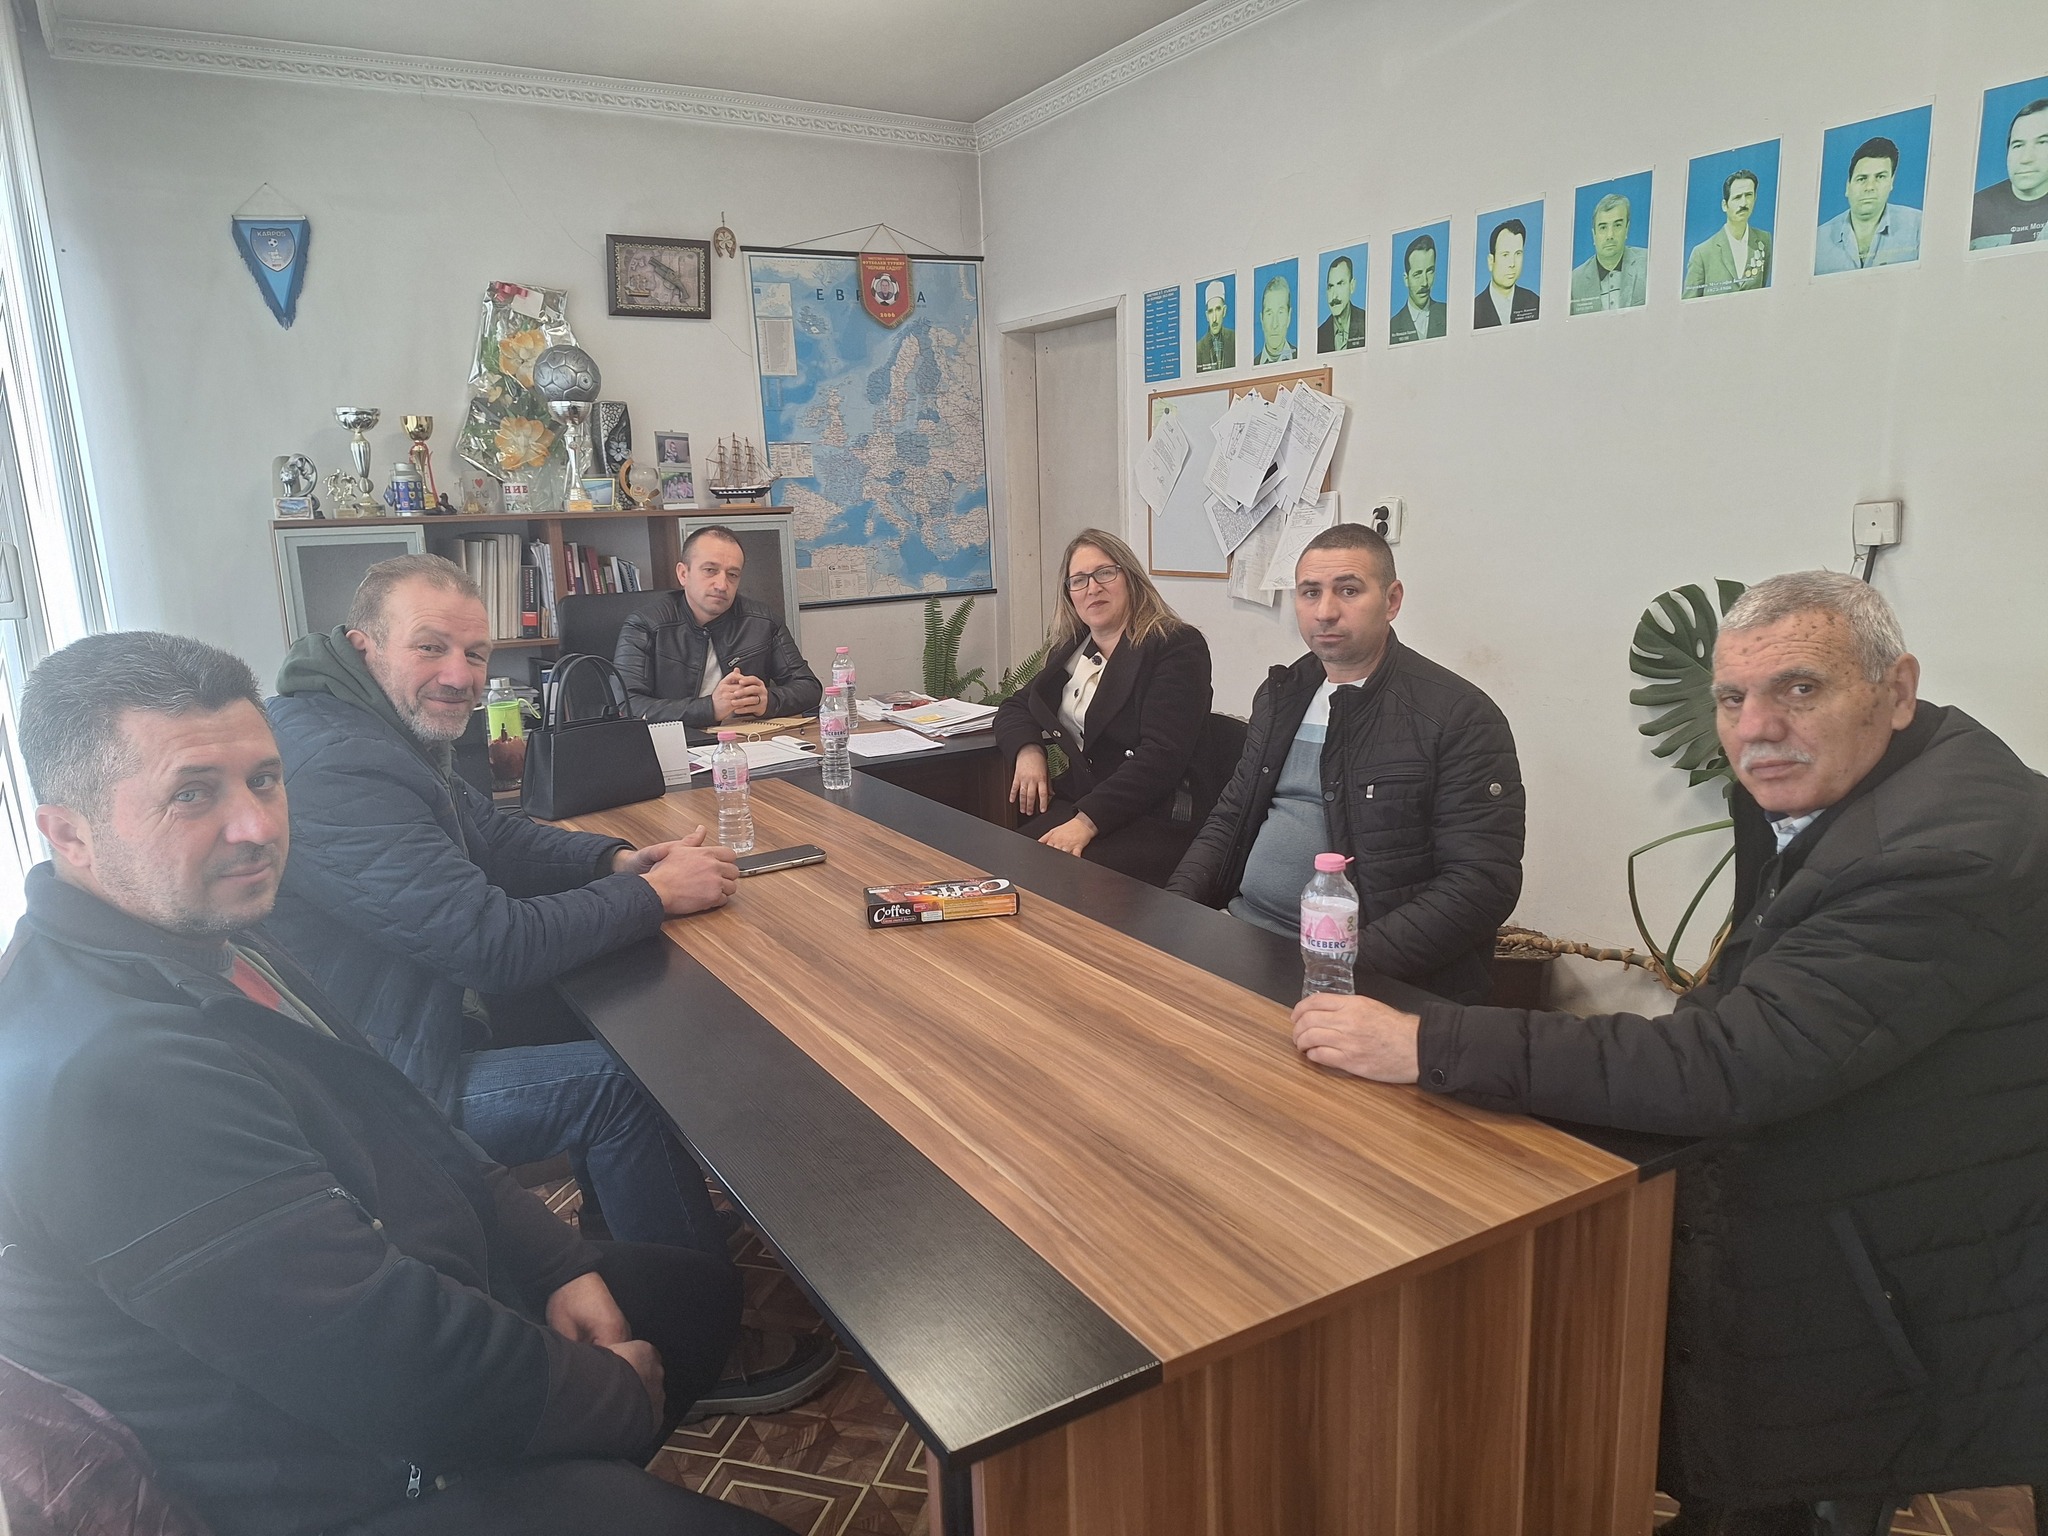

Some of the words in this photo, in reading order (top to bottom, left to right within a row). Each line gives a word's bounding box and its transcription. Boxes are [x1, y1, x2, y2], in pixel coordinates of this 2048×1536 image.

[504, 485, 529, 494] НИЕ
[904, 878, 1010, 898] Coffee
[874, 904, 911, 923] Coffee
[1308, 939, 1346, 949] ICEBERG
